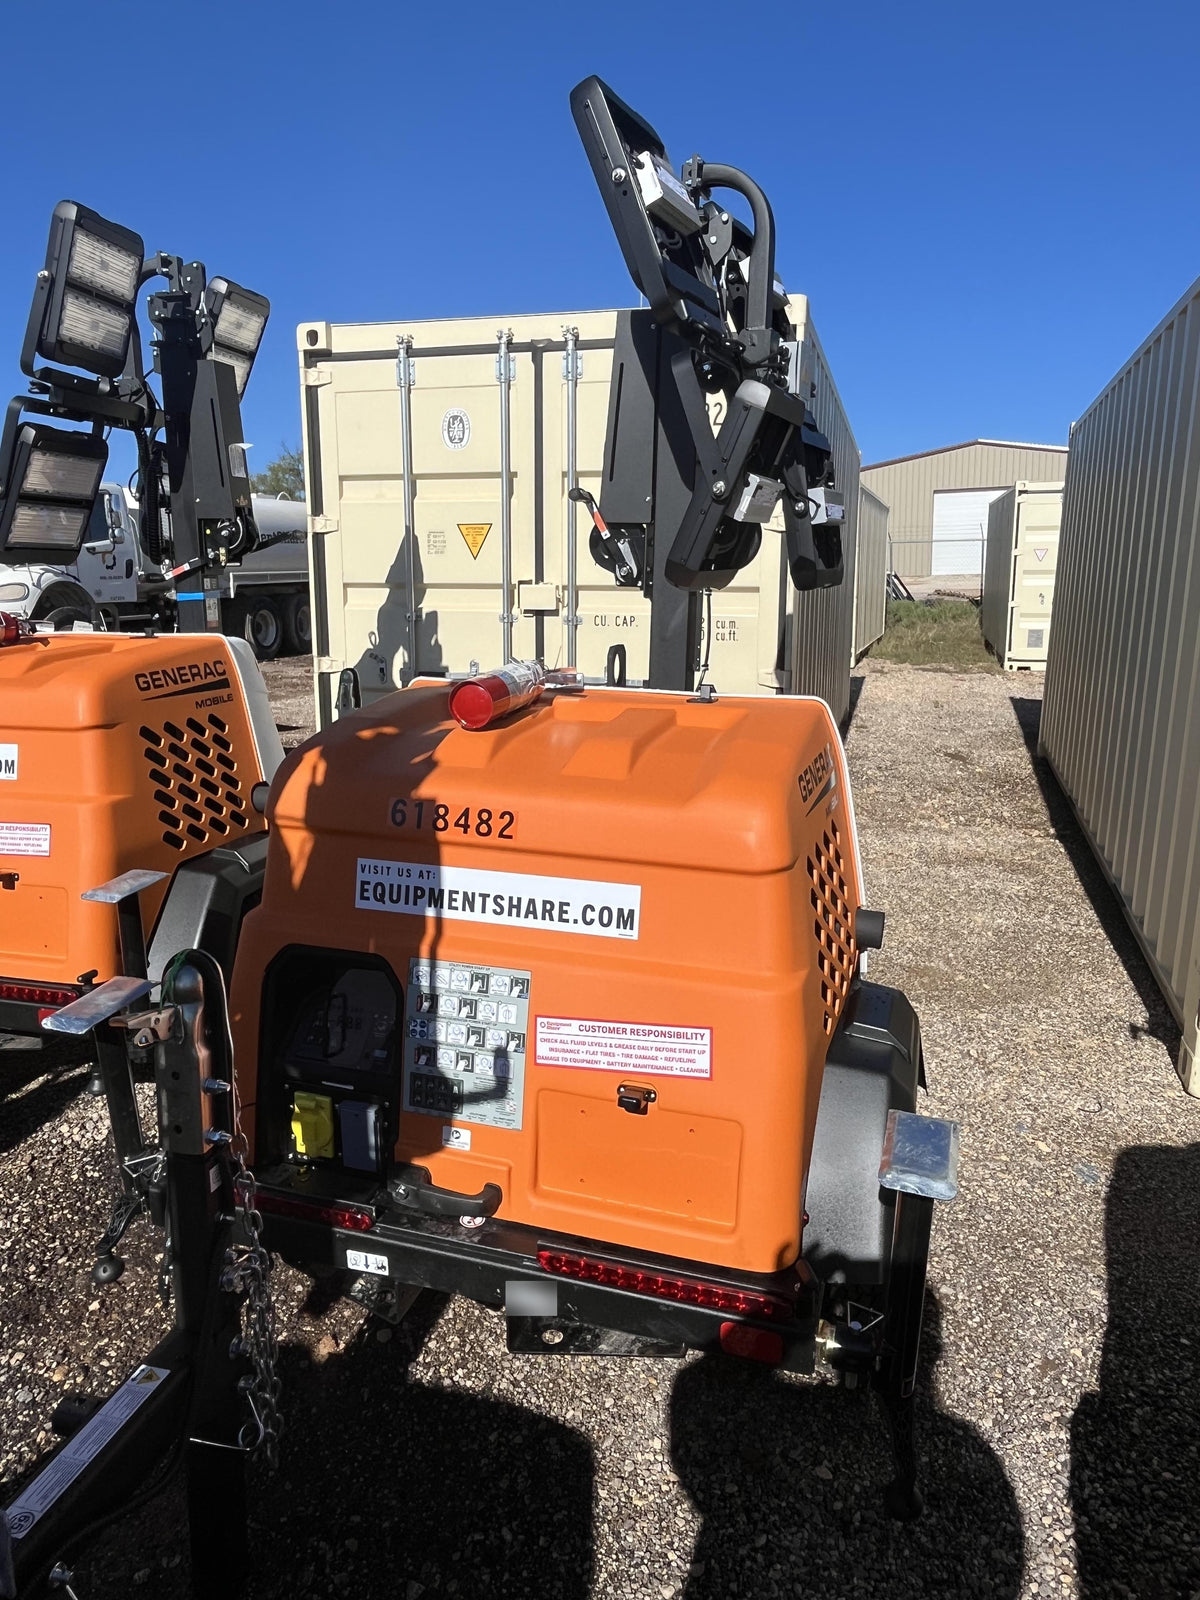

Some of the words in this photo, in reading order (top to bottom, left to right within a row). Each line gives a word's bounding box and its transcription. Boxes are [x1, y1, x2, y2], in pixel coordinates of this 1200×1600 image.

[594, 615, 609, 626] CU.
[615, 616, 638, 628] CAP.
[716, 620, 739, 630] cu.m.
[716, 630, 739, 642] cu.ft.
[134, 660, 226, 692] GENERAC
[195, 694, 234, 709] MOBILE
[391, 798, 514, 840] 618482
[360, 864, 391, 876] VISIT
[397, 868, 412, 878] US
[418, 870, 436, 880] AT:
[360, 880, 635, 930] EQUIPMENTSHARE.COM
[578, 1024, 627, 1035] CUSTOMER
[630, 1028, 705, 1040] RESPONSIBILITY
